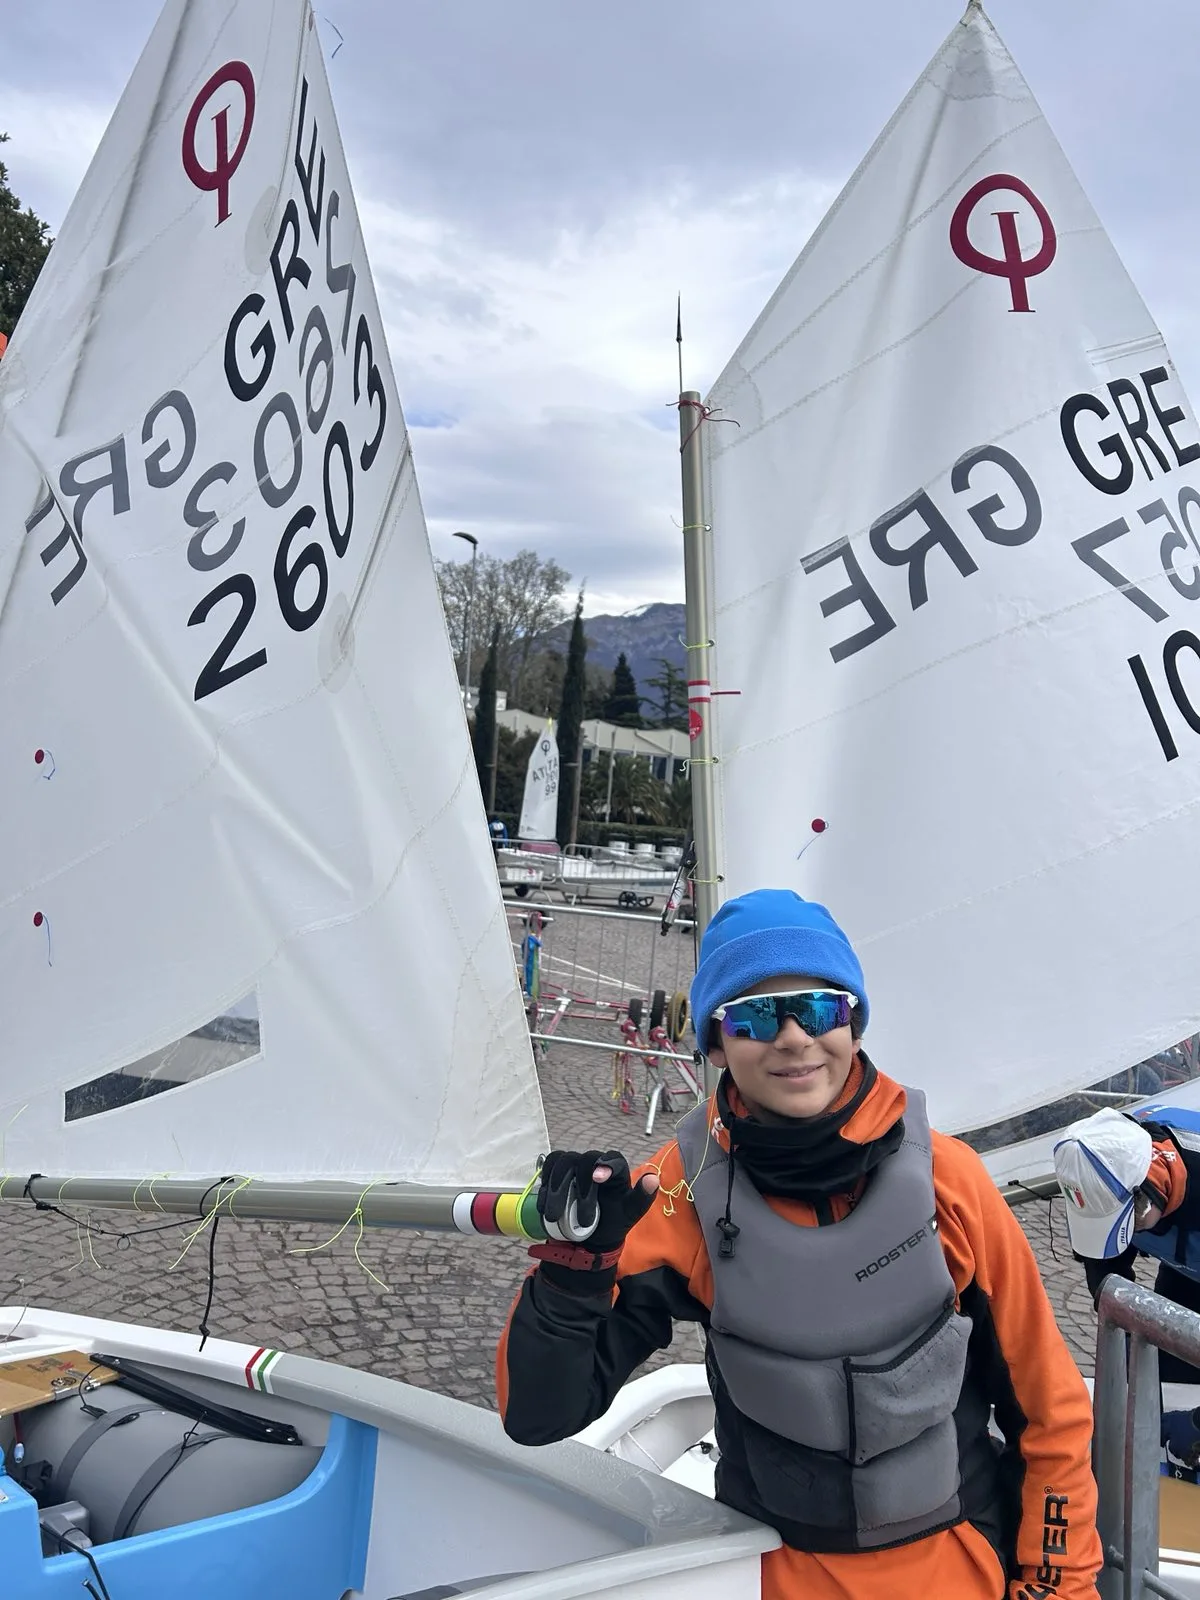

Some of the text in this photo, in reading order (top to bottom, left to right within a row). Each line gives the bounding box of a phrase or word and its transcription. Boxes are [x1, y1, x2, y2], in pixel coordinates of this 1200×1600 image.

[223, 76, 327, 403] GRE
[186, 313, 388, 702] 2603
[1059, 366, 1200, 496] GRE
[855, 1228, 928, 1282] ROOSTER
